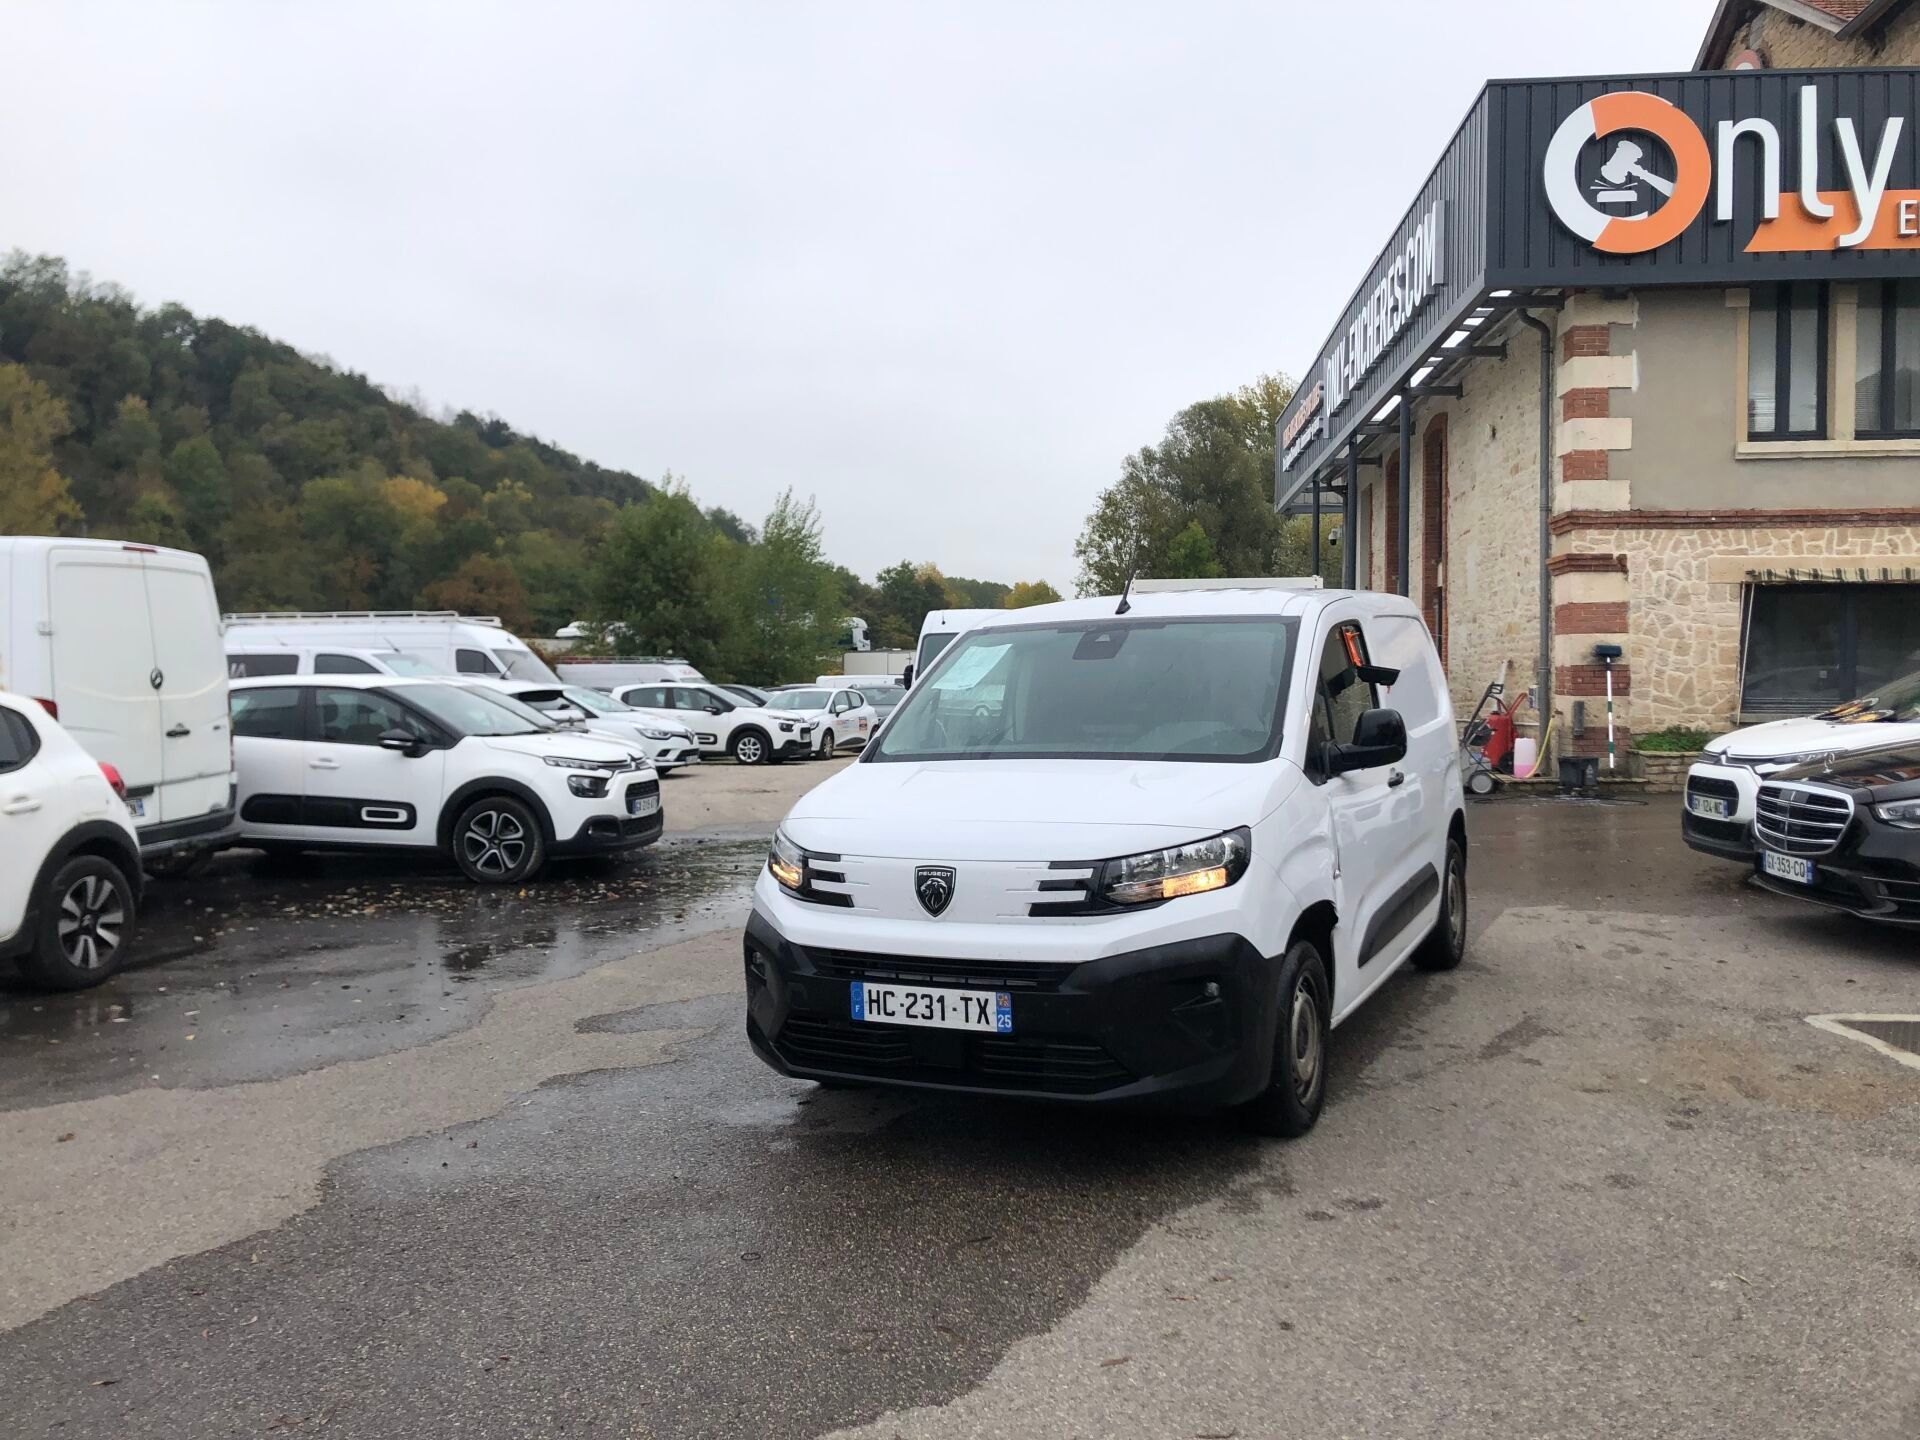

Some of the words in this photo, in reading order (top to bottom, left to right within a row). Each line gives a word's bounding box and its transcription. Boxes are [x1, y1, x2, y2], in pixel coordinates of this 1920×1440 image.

[855, 1005, 860, 1013] F
[868, 989, 990, 1025] HC-231-TX
[997, 1014, 1012, 1028] 25
